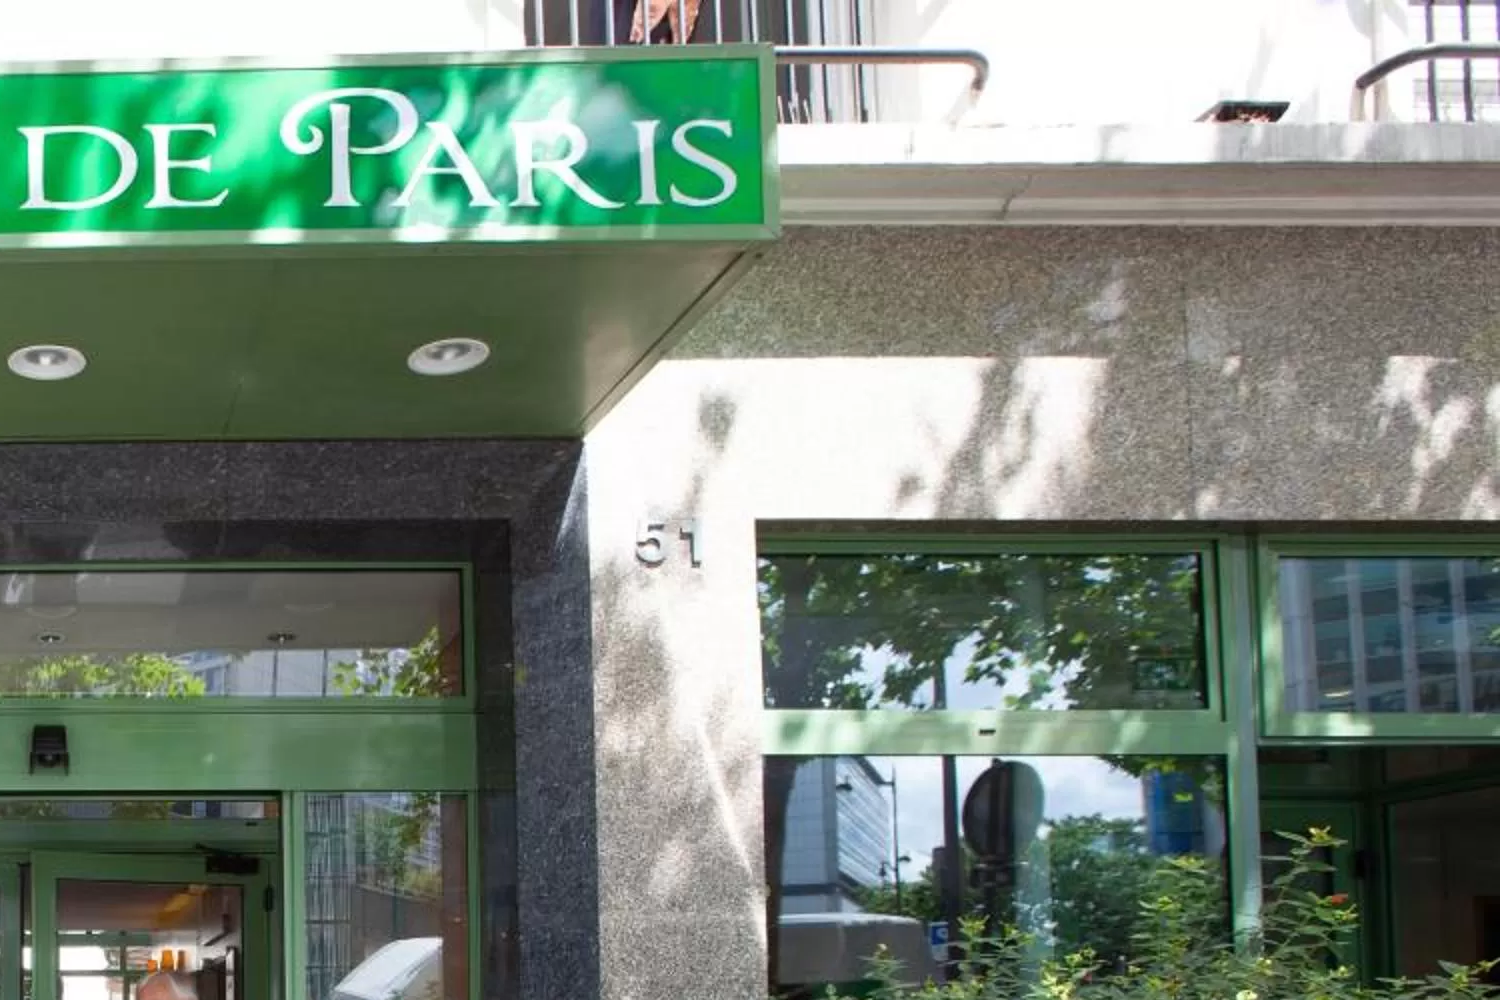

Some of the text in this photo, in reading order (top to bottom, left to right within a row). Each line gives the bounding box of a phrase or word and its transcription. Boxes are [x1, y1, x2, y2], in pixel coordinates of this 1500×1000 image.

[17, 122, 230, 211] DE
[279, 86, 739, 210] PARIS
[635, 517, 702, 568] 51
